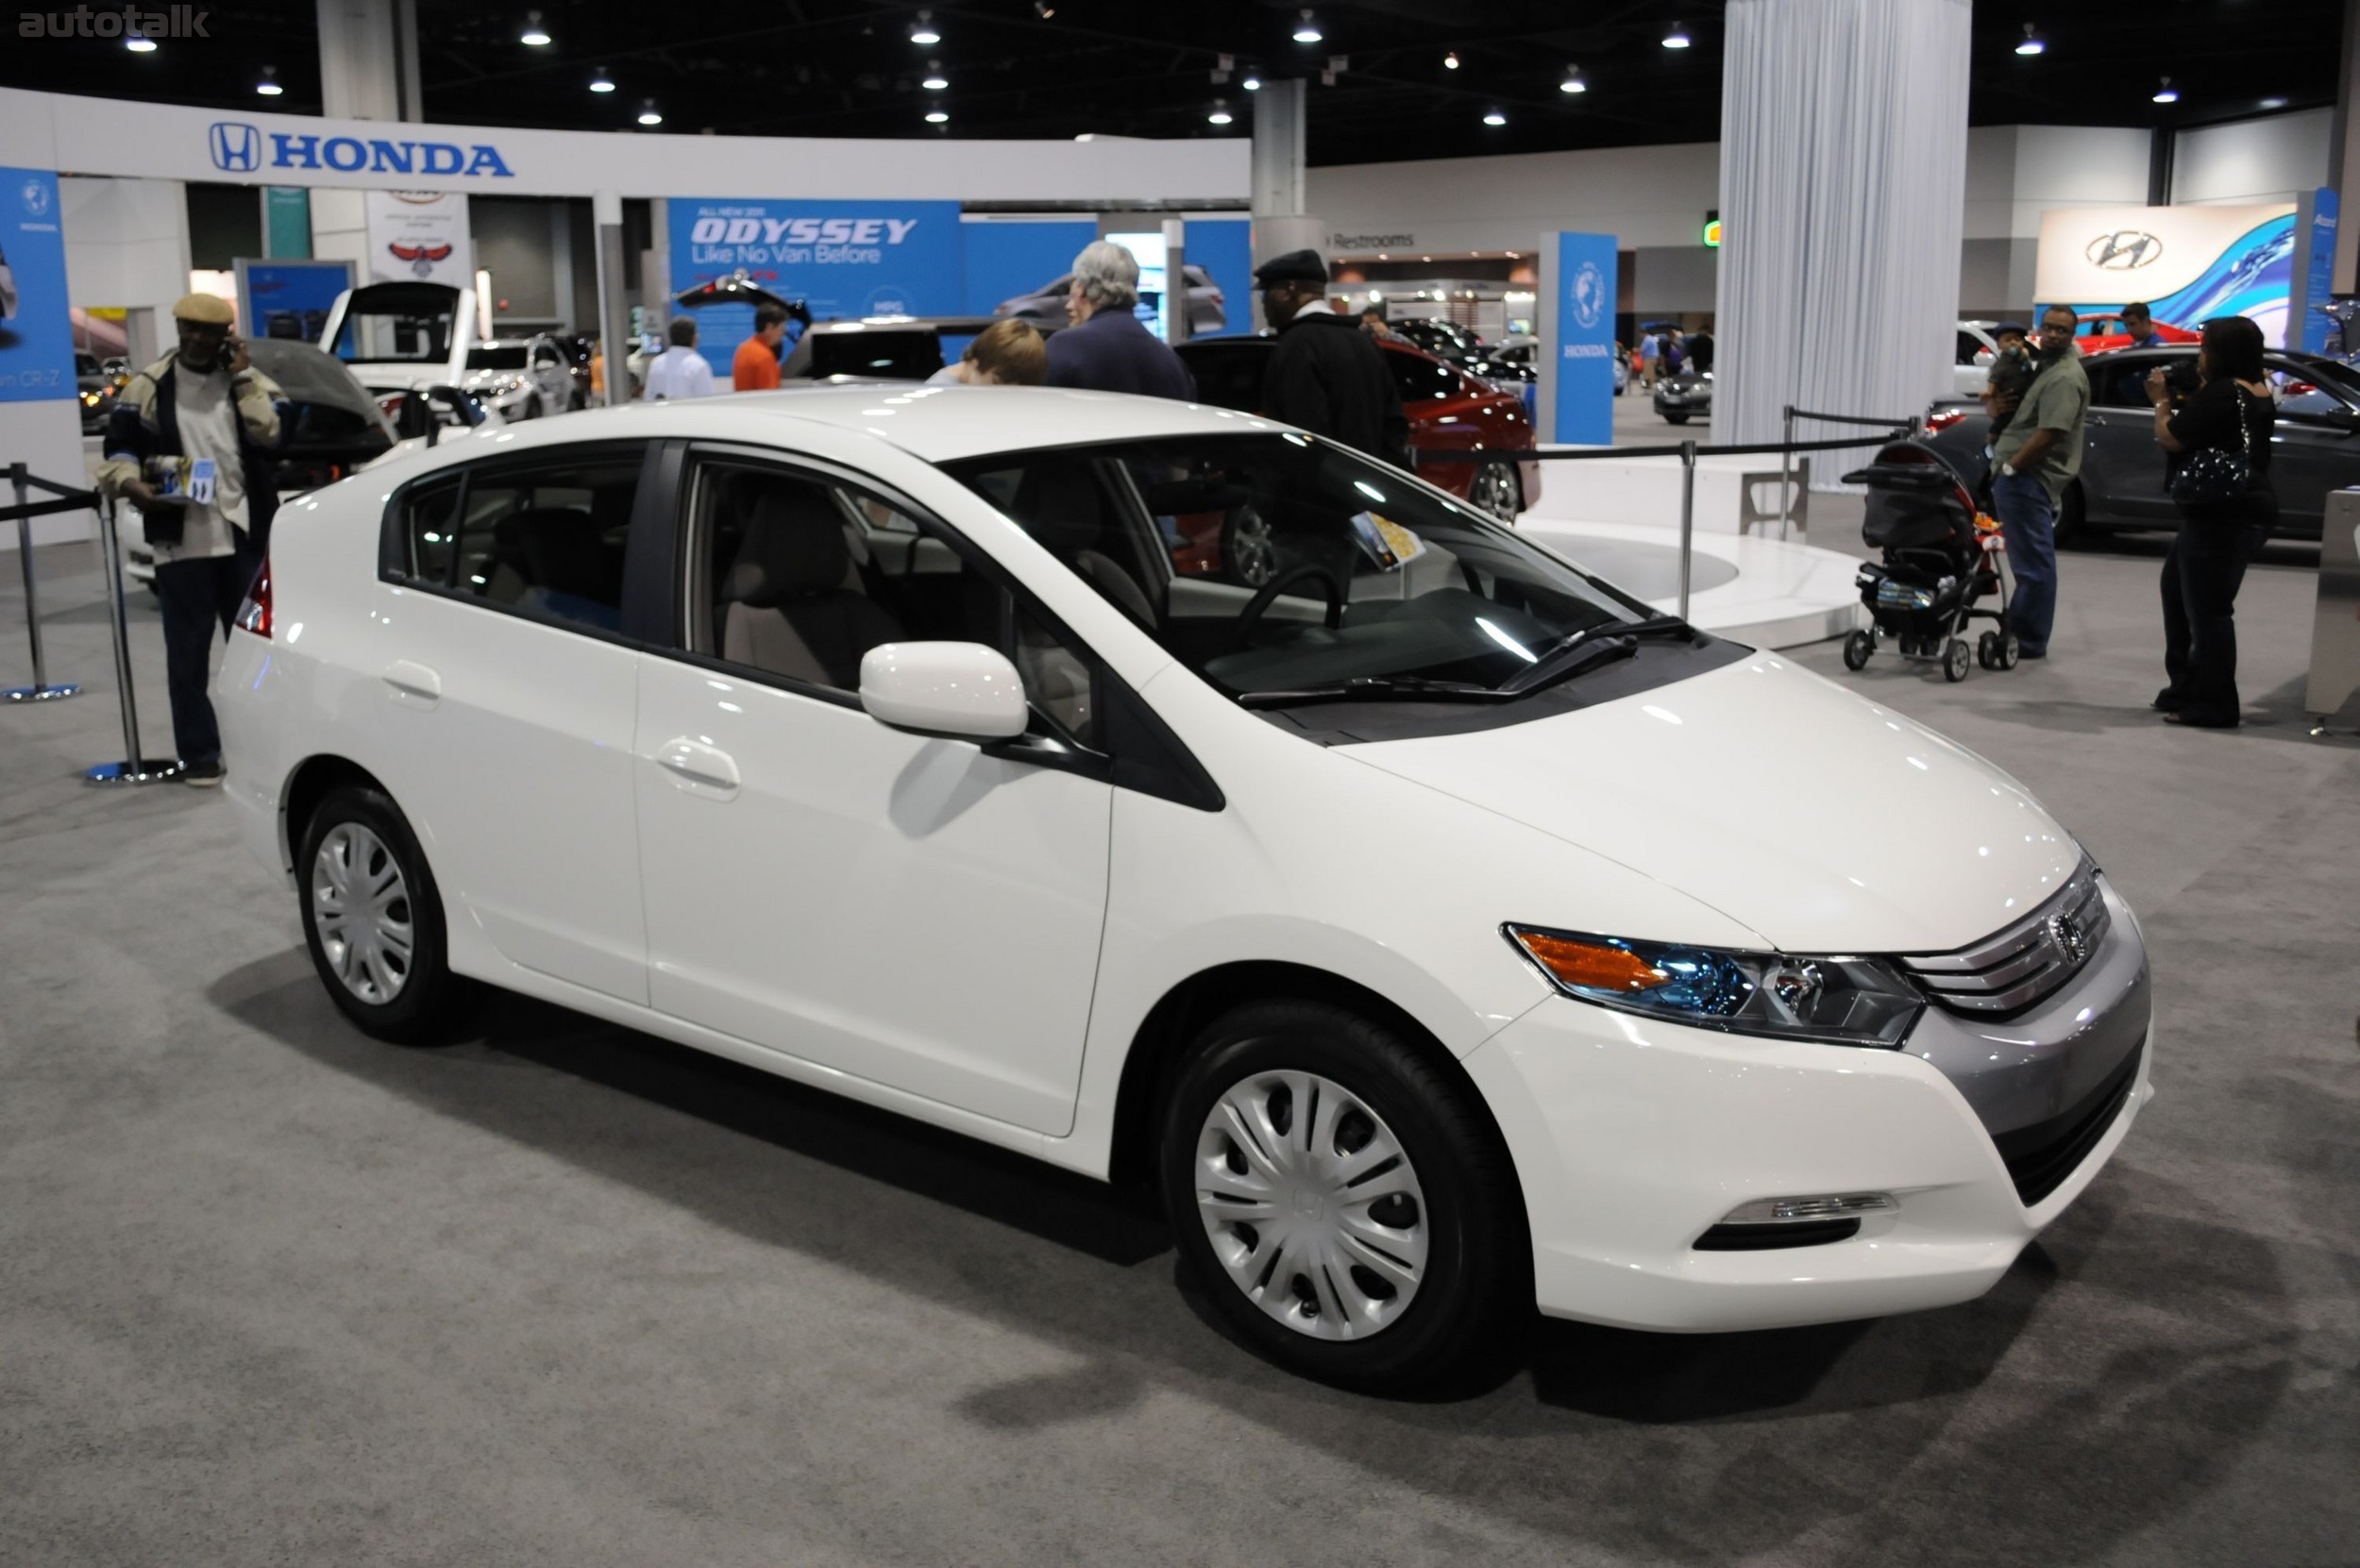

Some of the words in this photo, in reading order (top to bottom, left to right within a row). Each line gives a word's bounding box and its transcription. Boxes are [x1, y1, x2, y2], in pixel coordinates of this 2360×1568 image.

[270, 133, 515, 177] HONDA
[690, 218, 918, 244] ODYSSEY
[1334, 232, 1414, 248] Restrooms
[692, 245, 733, 264] Like
[737, 245, 769, 264] No
[771, 245, 812, 264] Van
[815, 245, 881, 264] Before
[1564, 345, 1609, 358] HONDA
